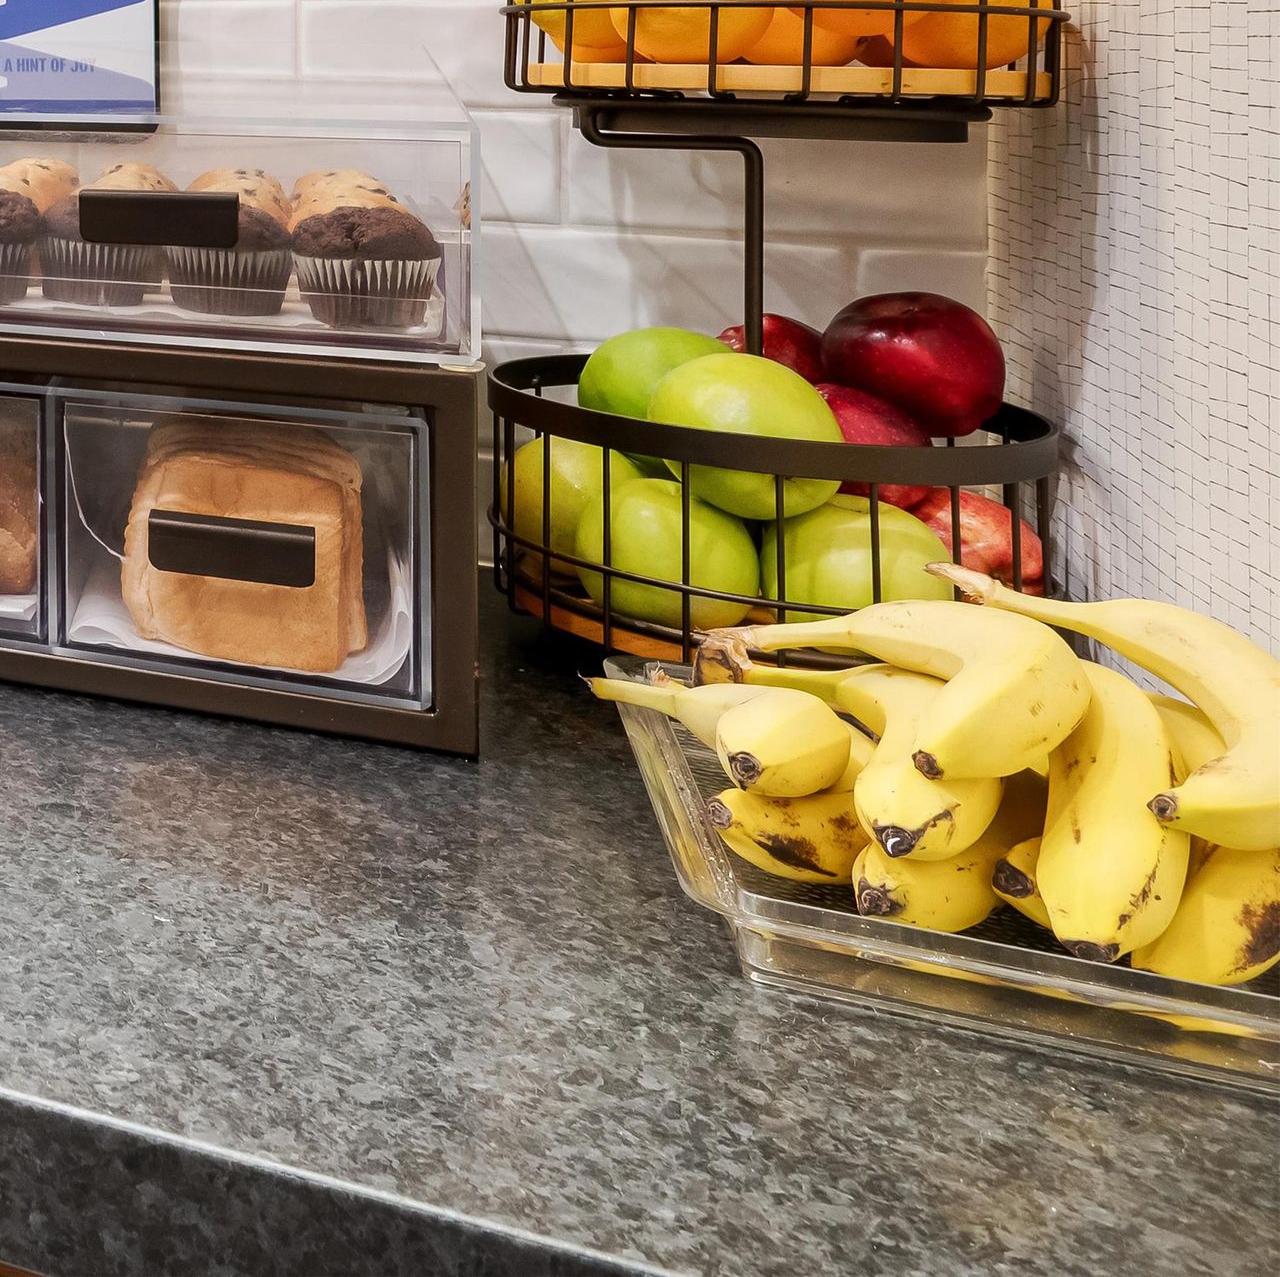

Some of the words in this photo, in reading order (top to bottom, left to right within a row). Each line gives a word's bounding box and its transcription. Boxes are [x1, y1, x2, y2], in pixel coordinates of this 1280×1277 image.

[4, 58, 13, 73] A
[16, 58, 47, 73] HINT
[50, 58, 66, 73] OF
[70, 58, 96, 73] JOY
